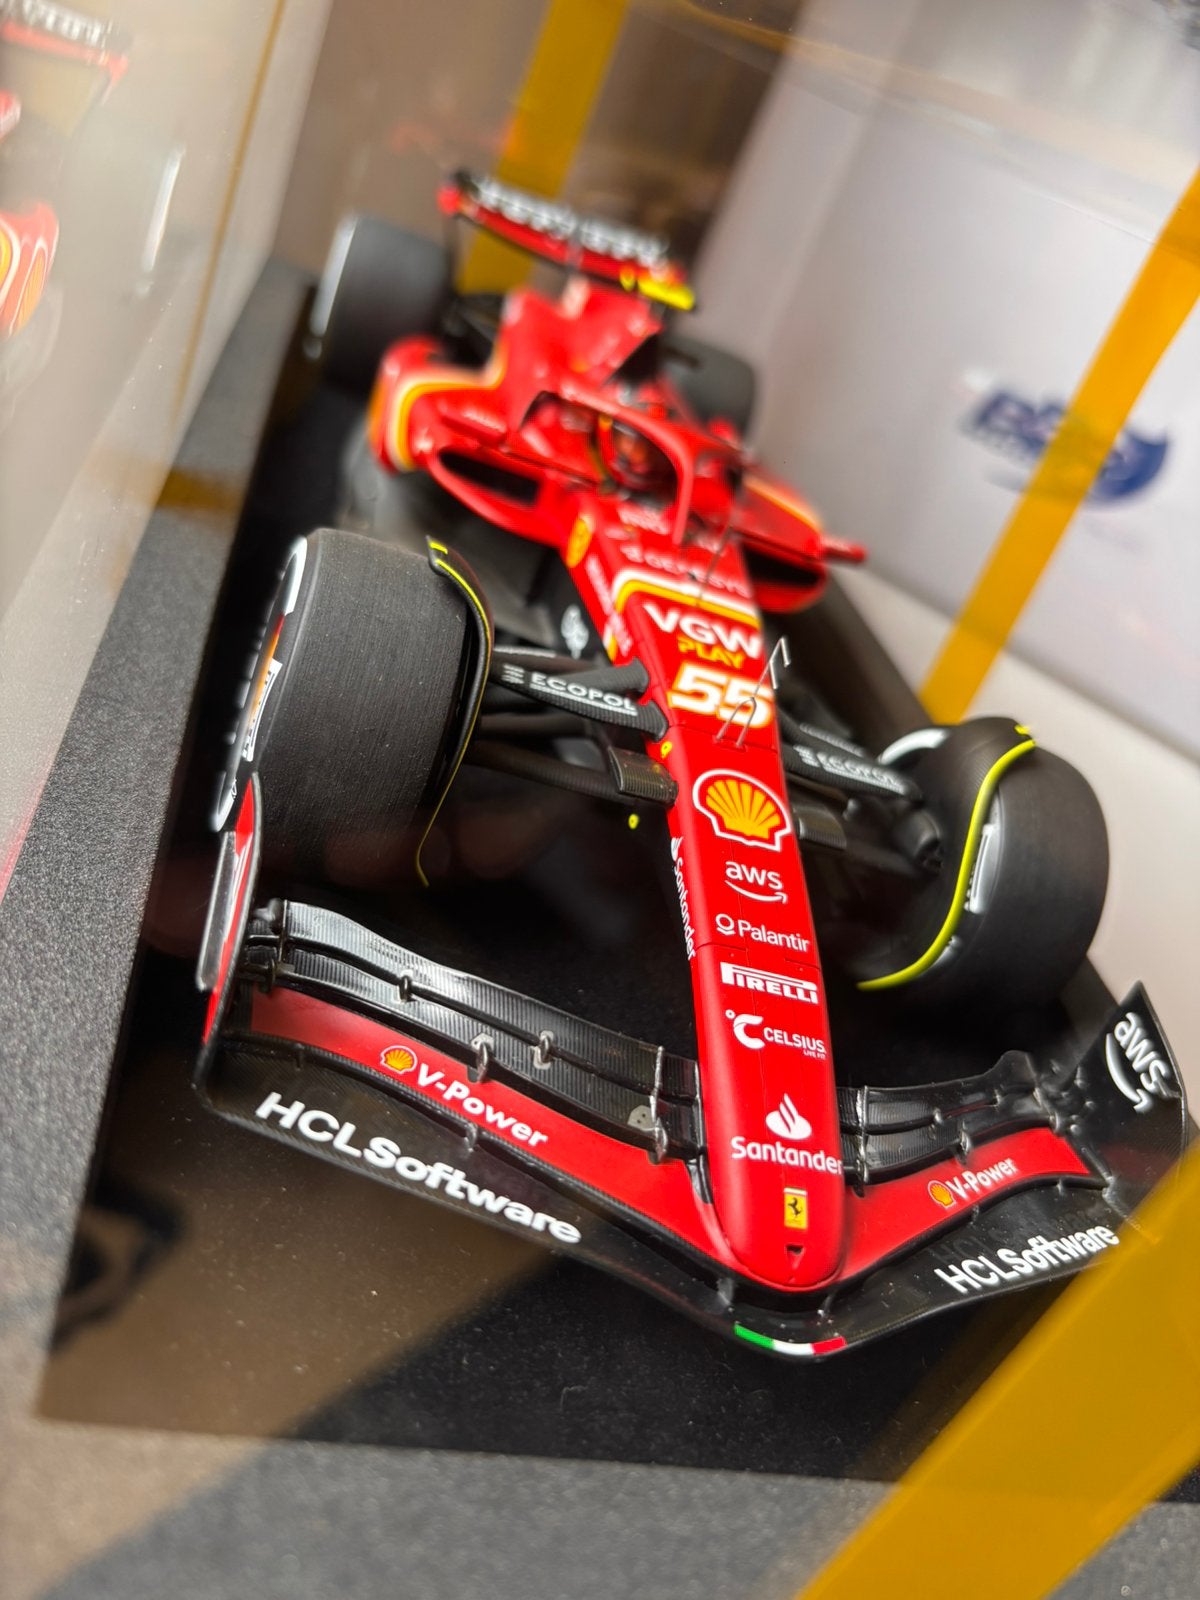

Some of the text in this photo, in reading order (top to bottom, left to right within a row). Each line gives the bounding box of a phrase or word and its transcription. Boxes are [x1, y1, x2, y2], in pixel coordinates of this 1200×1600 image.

[643, 603, 762, 658] VGW
[678, 635, 744, 668] PLAY
[531, 671, 637, 711] ECOPOL
[667, 660, 774, 728] 55
[725, 861, 783, 890] aws
[674, 857, 696, 960] Santander
[738, 918, 810, 952] Palantir
[720, 962, 818, 1004] PIRELLI
[764, 1027, 825, 1052] CELSIUS
[1114, 1011, 1169, 1095] aws
[417, 1063, 548, 1146] V-Power
[255, 1092, 581, 1244] HCLSoftware
[731, 1137, 842, 1175] Santander
[949, 1157, 1018, 1199] V-Power
[934, 1225, 1120, 1294] HCLSoftware
